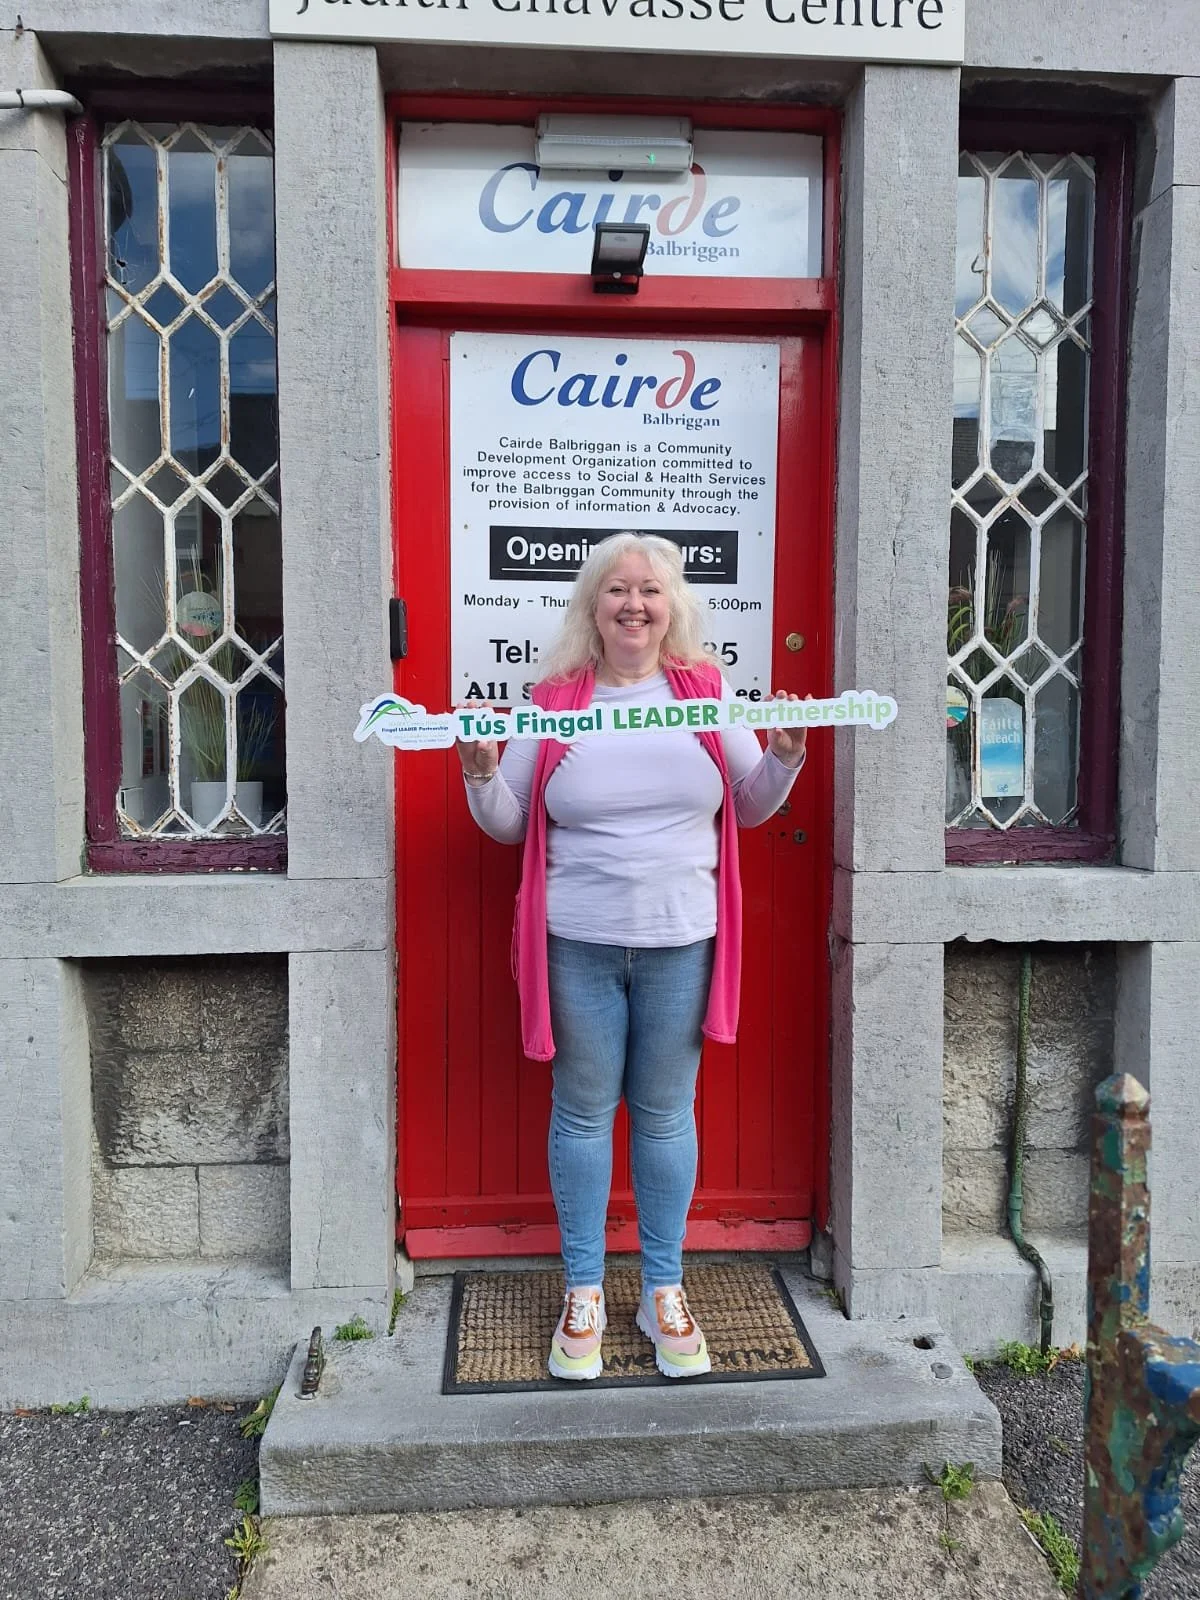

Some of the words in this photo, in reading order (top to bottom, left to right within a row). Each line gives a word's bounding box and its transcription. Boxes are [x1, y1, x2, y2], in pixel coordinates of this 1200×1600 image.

[478, 162, 741, 238] Cairde
[510, 349, 722, 411] Cairde
[642, 412, 720, 431] Balbriggan
[499, 436, 543, 450] Cairde
[549, 438, 621, 454] Balbriggan
[626, 440, 638, 453] is
[643, 444, 651, 453] a
[657, 441, 732, 457] Community
[477, 451, 566, 466] Development
[572, 454, 656, 469] Organization
[662, 457, 733, 470] committed
[739, 459, 753, 470] to
[463, 465, 517, 480] improve
[522, 470, 571, 481] access
[578, 470, 591, 481] to
[597, 470, 639, 482] Social
[644, 471, 654, 483] &
[660, 471, 703, 484] Health
[708, 472, 766, 486] Services
[471, 481, 490, 493] for
[496, 482, 517, 494] the
[523, 483, 595, 498] Balbriggan
[601, 485, 675, 500] Community
[681, 487, 732, 502] through
[738, 488, 759, 500] the
[489, 498, 550, 511] provision
[555, 499, 570, 511] of
[575, 500, 651, 513] information
[656, 501, 666, 513] &
[672, 502, 741, 517] Advocacy.
[464, 594, 520, 609] Monday
[708, 598, 762, 613] 5:00pm
[489, 639, 539, 664] Tel:
[458, 714, 506, 736] Tús
[516, 708, 603, 738] Fingal
[613, 704, 719, 730] LEADER
[728, 697, 893, 724] Partnership
